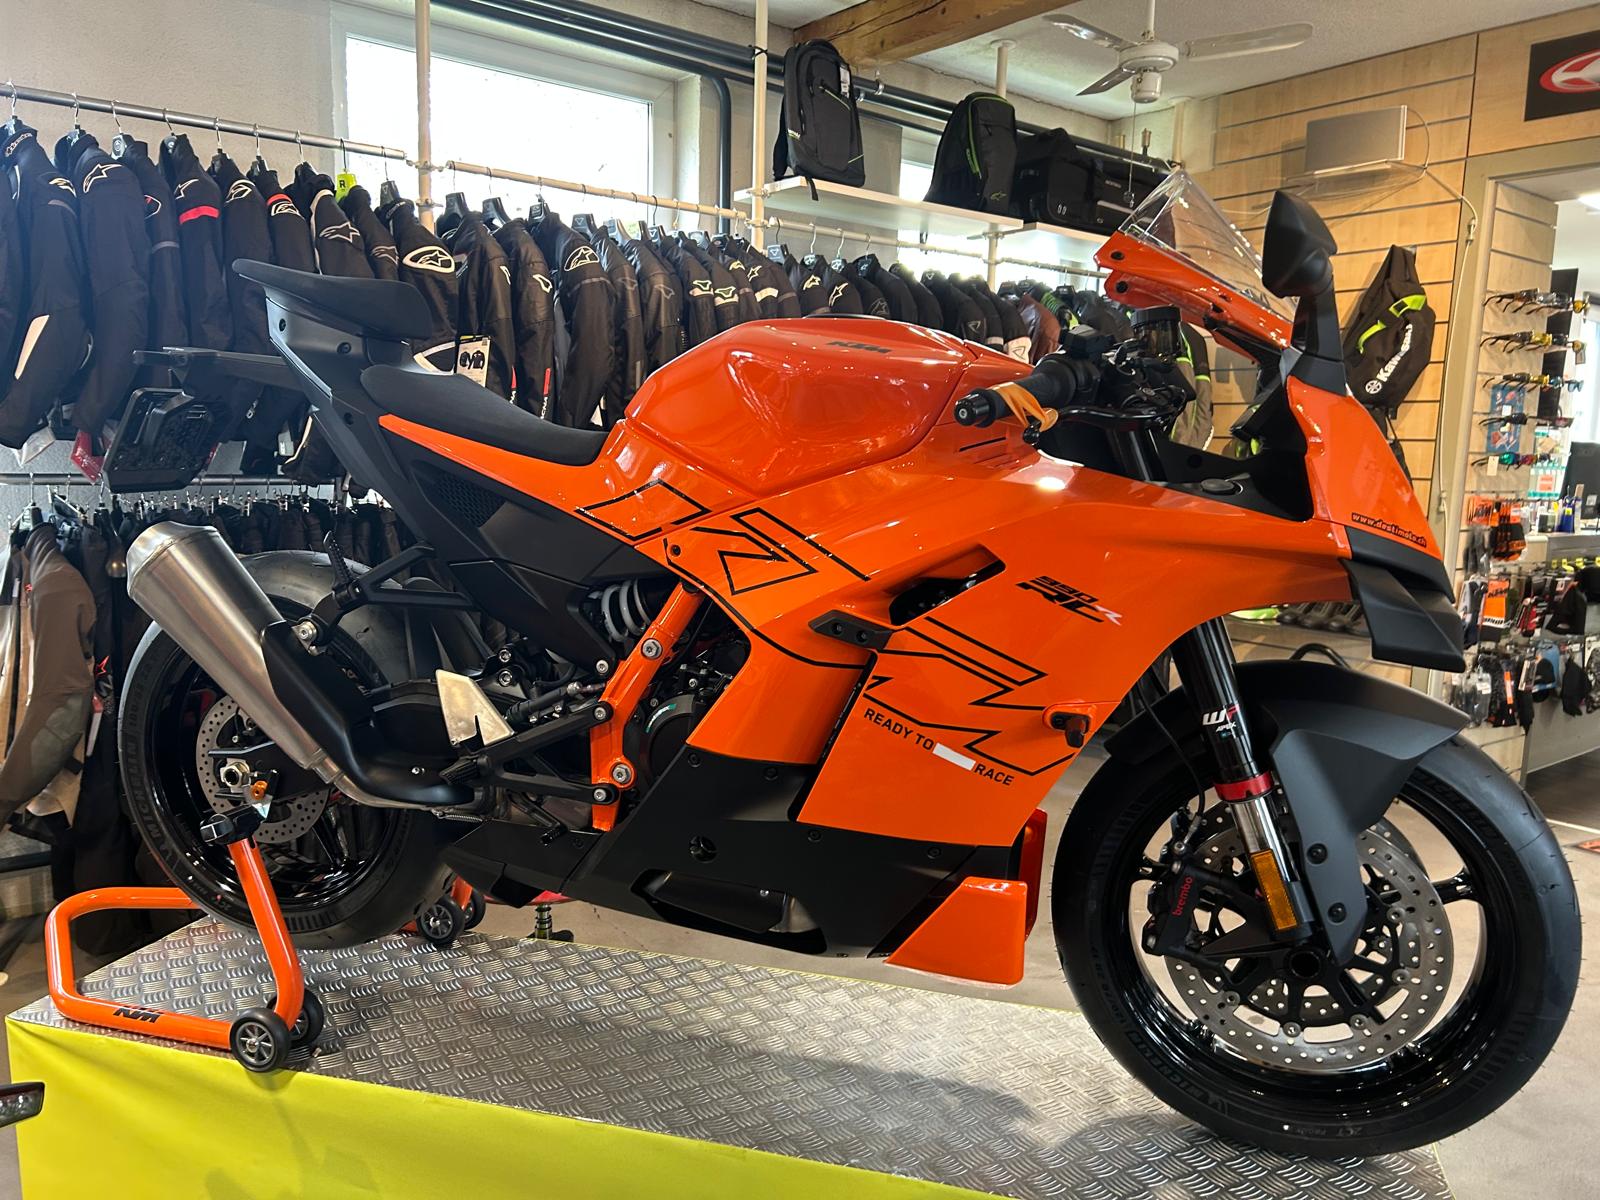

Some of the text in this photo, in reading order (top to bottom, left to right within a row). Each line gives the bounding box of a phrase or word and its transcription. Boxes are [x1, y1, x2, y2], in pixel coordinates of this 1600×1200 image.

[864, 708, 1015, 786] READY TO RACE
[1171, 876, 1193, 916] brembo
[112, 1005, 163, 1024] KTM
